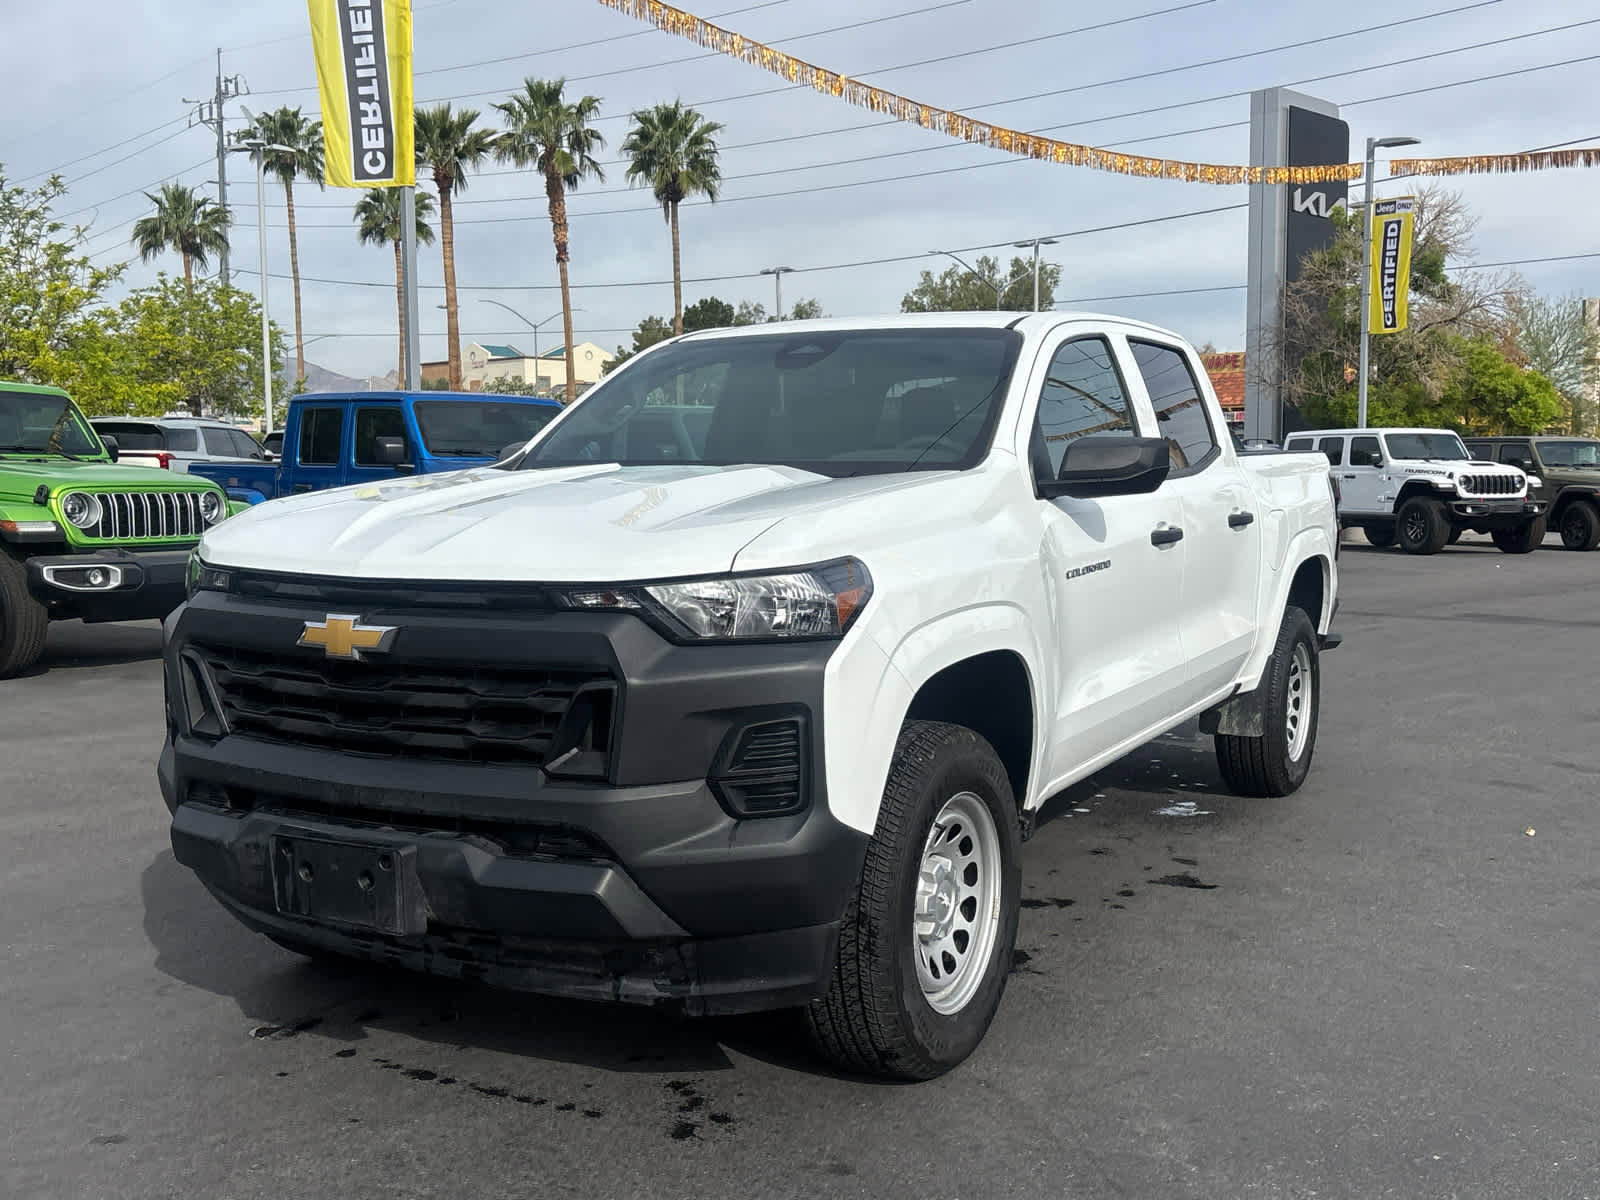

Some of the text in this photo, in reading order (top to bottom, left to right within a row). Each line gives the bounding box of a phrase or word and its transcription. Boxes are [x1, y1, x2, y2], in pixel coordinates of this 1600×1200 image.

[1293, 187, 1347, 218] KIA
[1396, 202, 1412, 210] ONLY
[1383, 222, 1399, 326] CERTIFIED
[1206, 354, 1241, 369] VAPE
[1066, 559, 1111, 580] COLORADO
